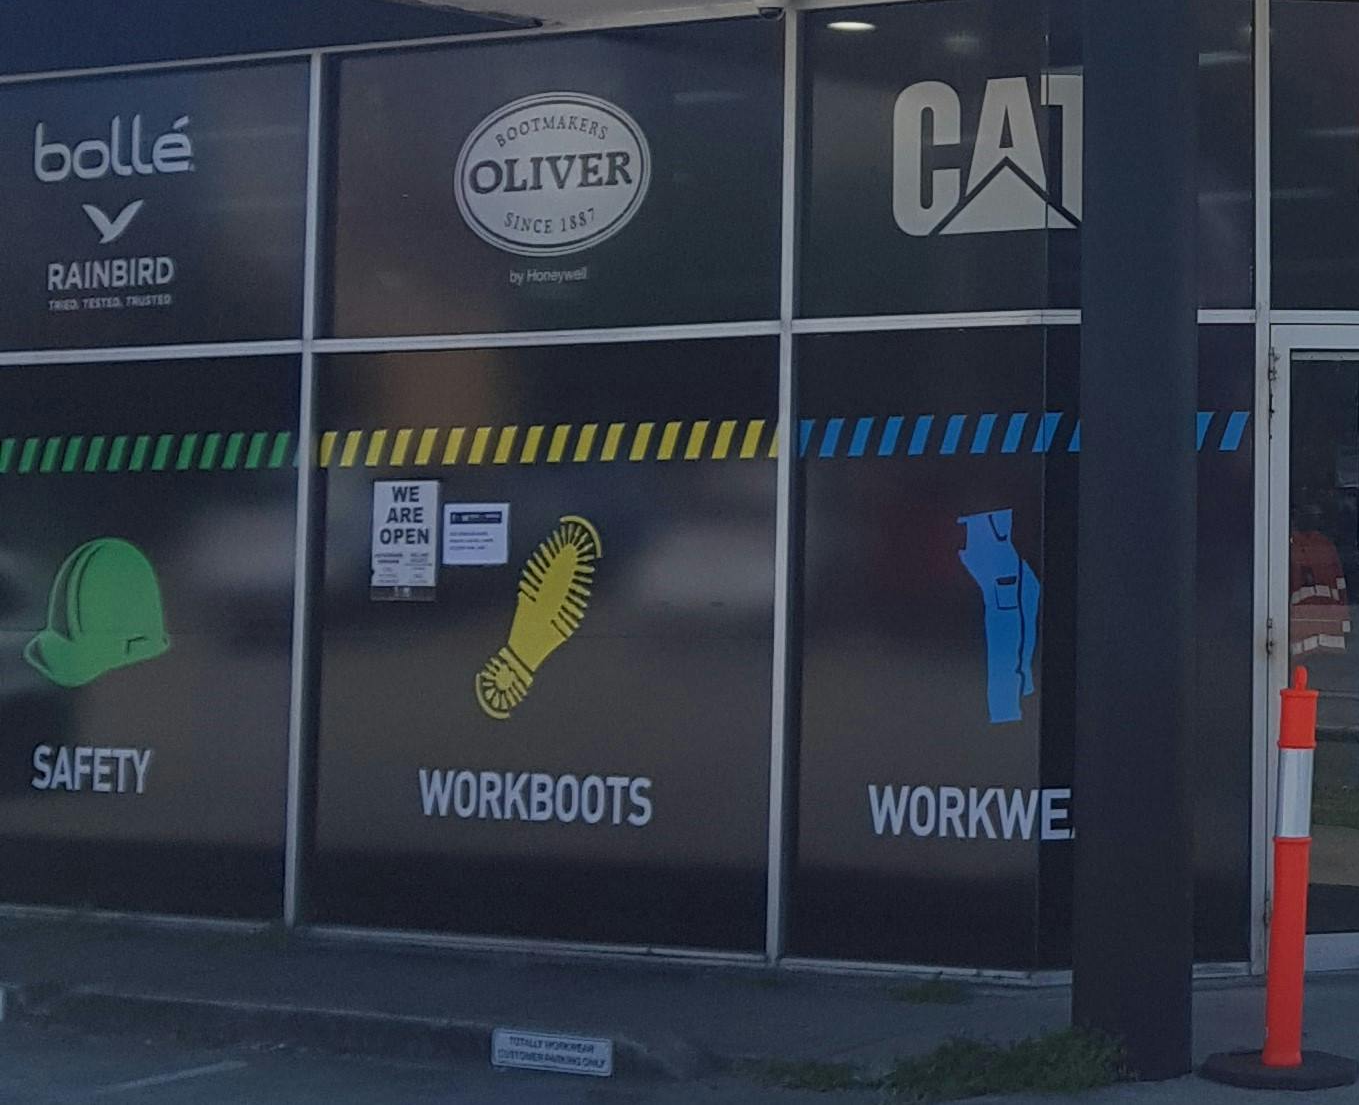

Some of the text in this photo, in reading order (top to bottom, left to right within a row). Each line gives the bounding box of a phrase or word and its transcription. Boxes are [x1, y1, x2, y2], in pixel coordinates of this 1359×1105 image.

[34, 113, 193, 182] bollé
[495, 115, 609, 147] BOOTMAKERS
[469, 151, 633, 194] OLIVER
[504, 207, 595, 234] SINCE 1887
[47, 256, 175, 290] RAINBIRD
[509, 266, 588, 286] by Honeywell
[392, 485, 420, 503] WE
[386, 506, 424, 524] ARE
[379, 527, 430, 545] OPEN
[31, 744, 152, 794] SAFETY
[418, 767, 653, 826] WORKBOOTS
[867, 783, 1075, 841] WORKWE
